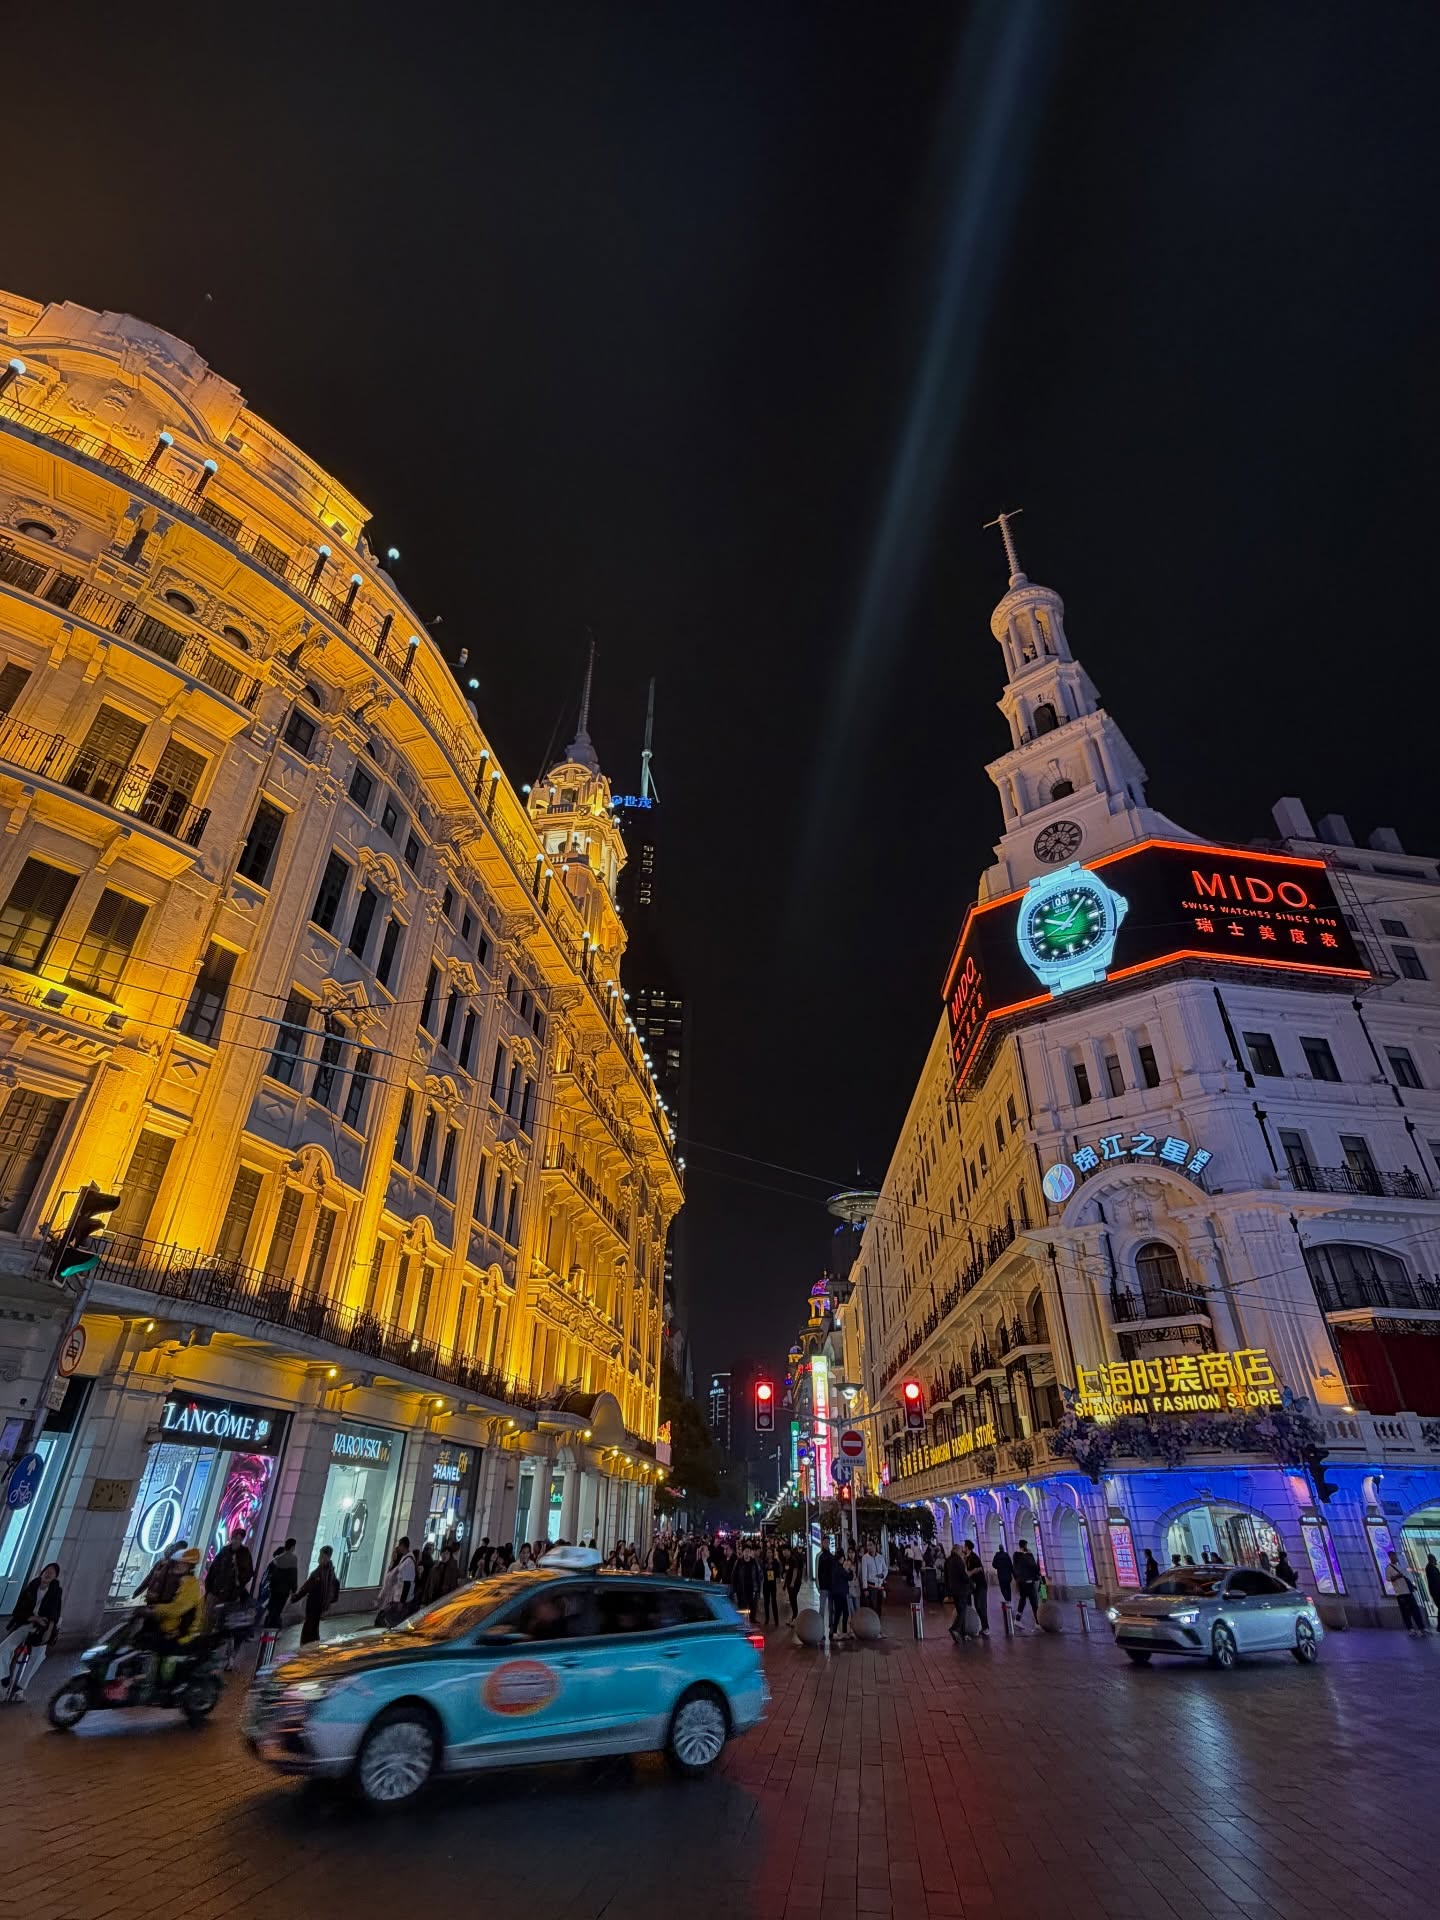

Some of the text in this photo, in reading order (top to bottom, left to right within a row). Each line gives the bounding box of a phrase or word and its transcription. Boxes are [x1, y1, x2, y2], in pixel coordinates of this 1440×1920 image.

[624, 795, 652, 808] 世茂
[1181, 901, 1338, 928] SWISS WATCHES SINCE 1918
[1195, 917, 1339, 948] 瑞士美度表
[1075, 1348, 1275, 1399] 上海时装商店
[1075, 1389, 1282, 1417] SHANGHAI FASHION STORE
[163, 1403, 255, 1440] LANCÔME
[951, 1431, 974, 1458] FASHION
[975, 1422, 997, 1448] STORE
